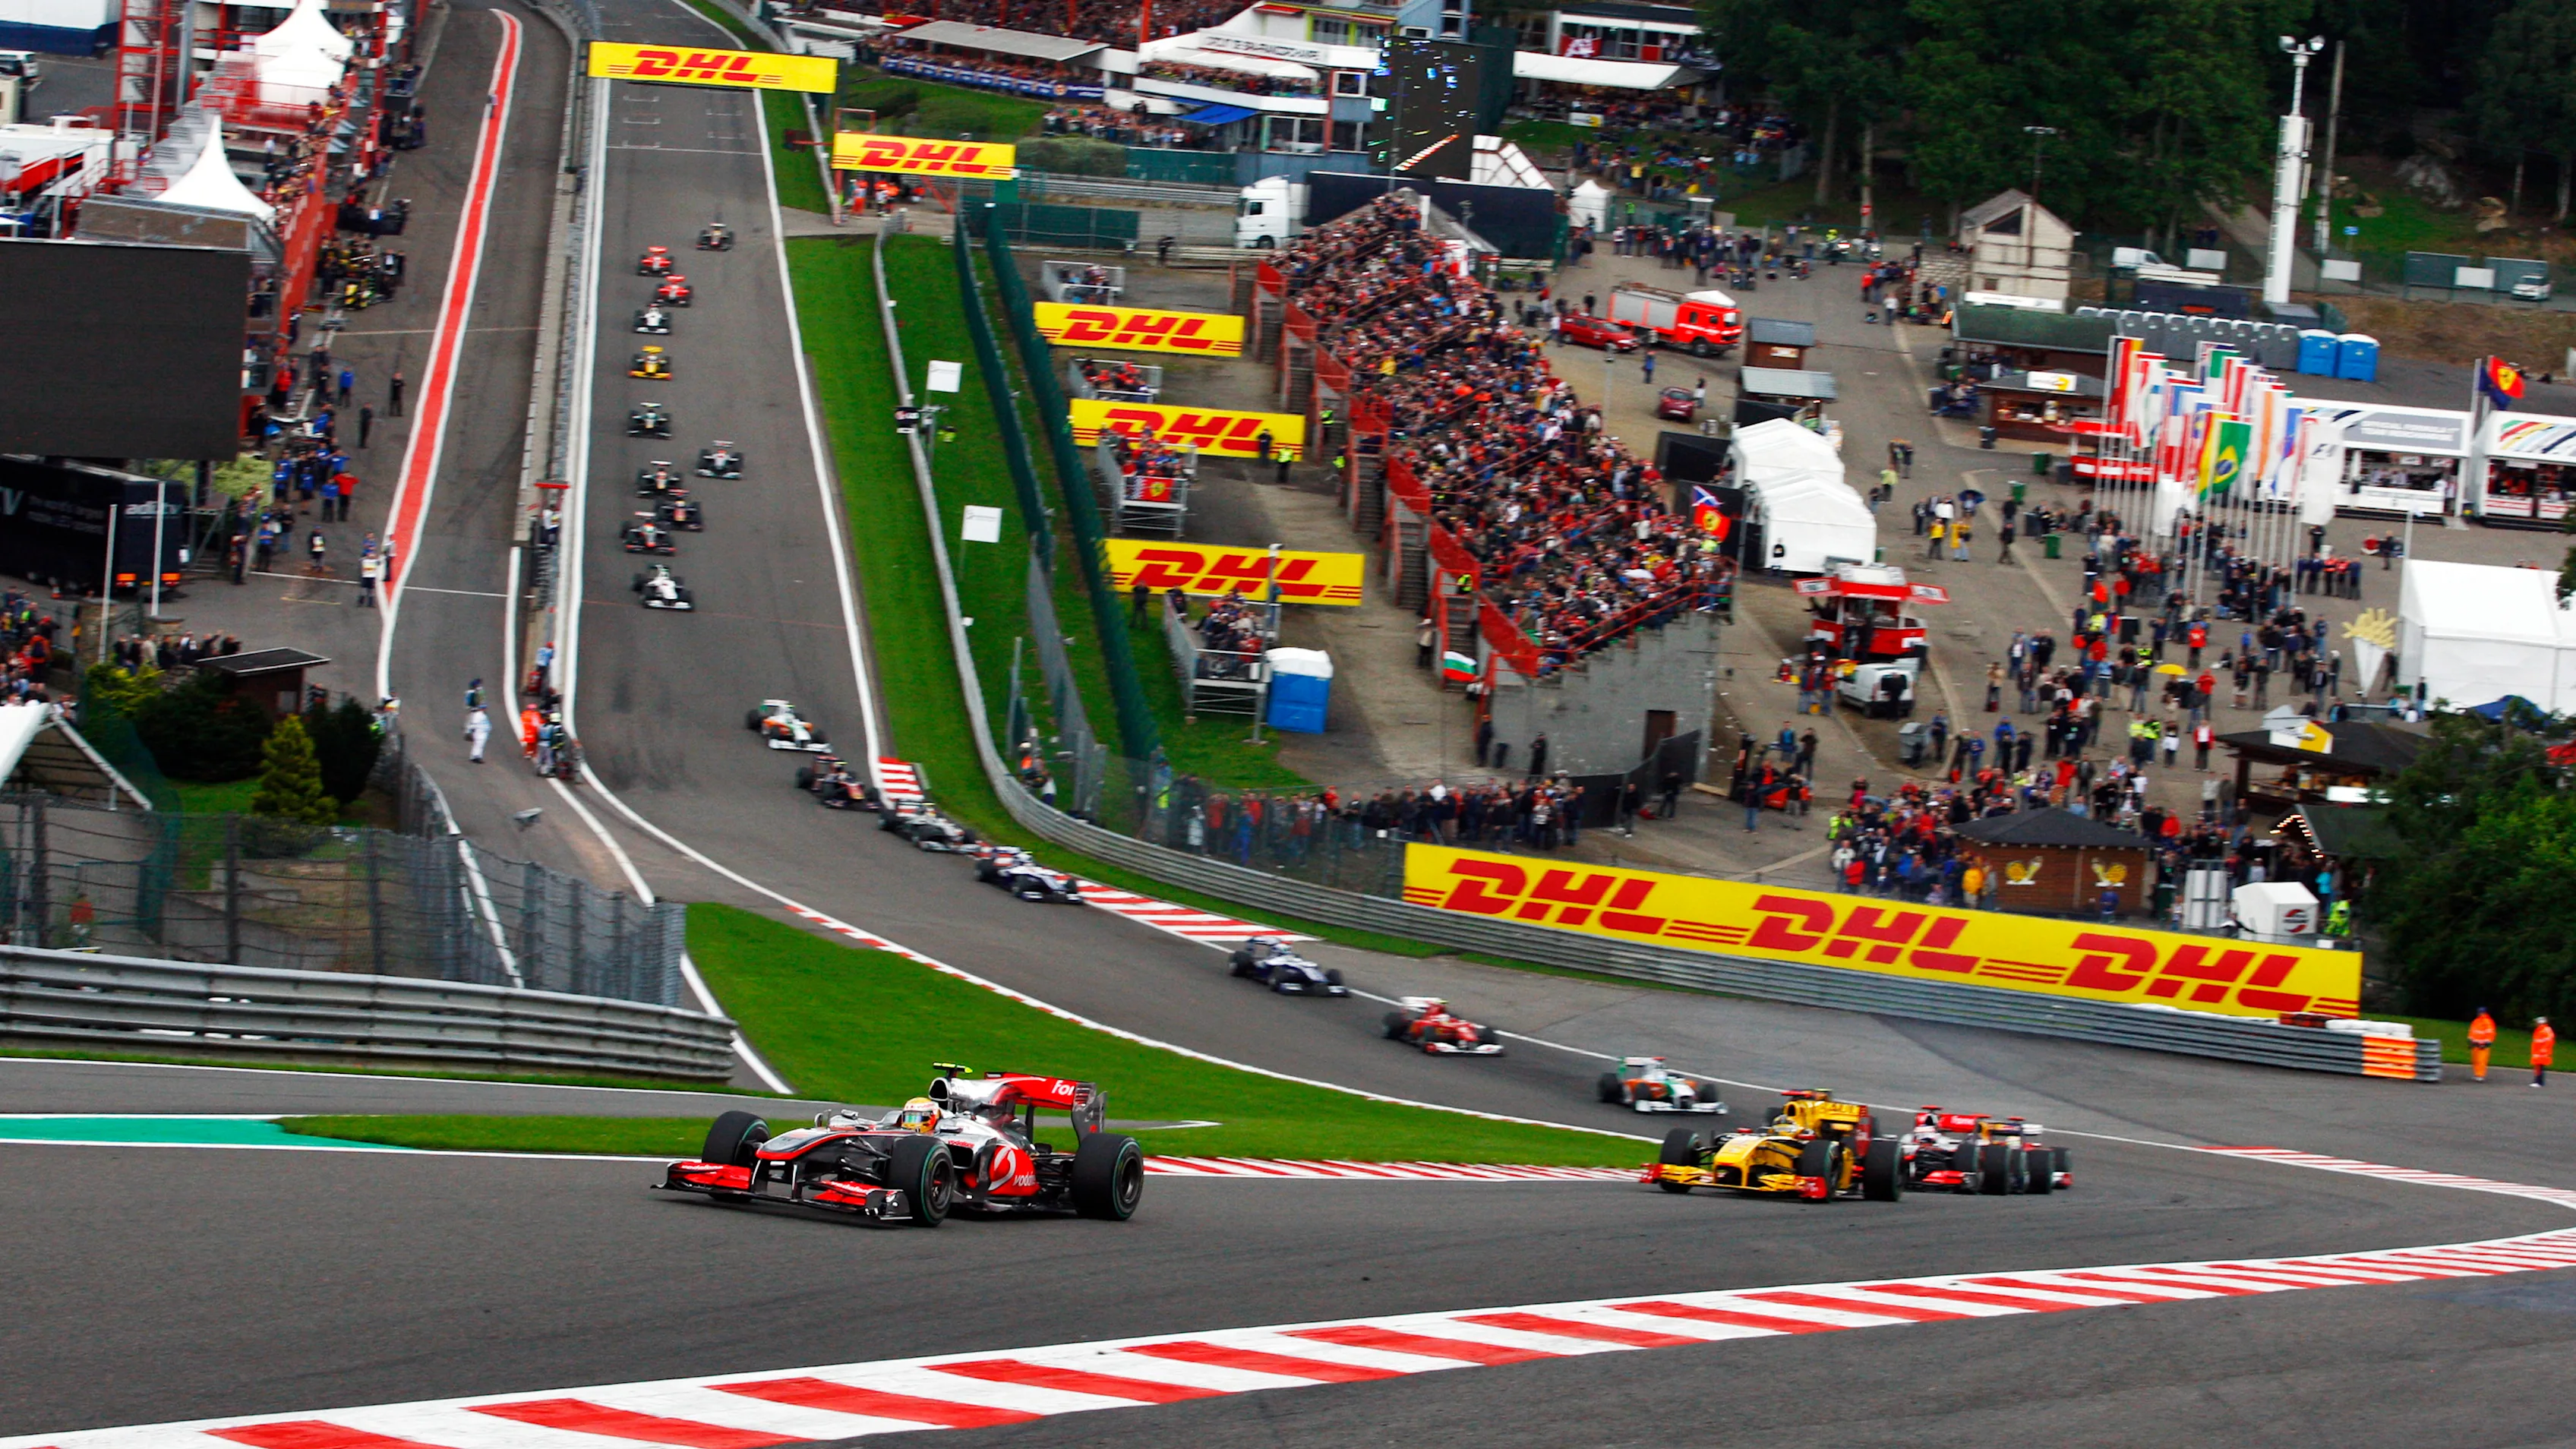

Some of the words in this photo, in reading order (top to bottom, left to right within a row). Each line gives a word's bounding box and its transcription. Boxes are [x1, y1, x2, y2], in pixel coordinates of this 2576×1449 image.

[633, 51, 757, 81] DHL
[860, 142, 987, 172] DHL
[1062, 311, 1212, 349] DHL
[1100, 409, 1261, 453] DHL
[1130, 549, 1326, 597] DHL
[1443, 859, 1665, 935] DHL
[1747, 895, 1980, 974] DHL
[2065, 933, 2311, 1012] DHL
